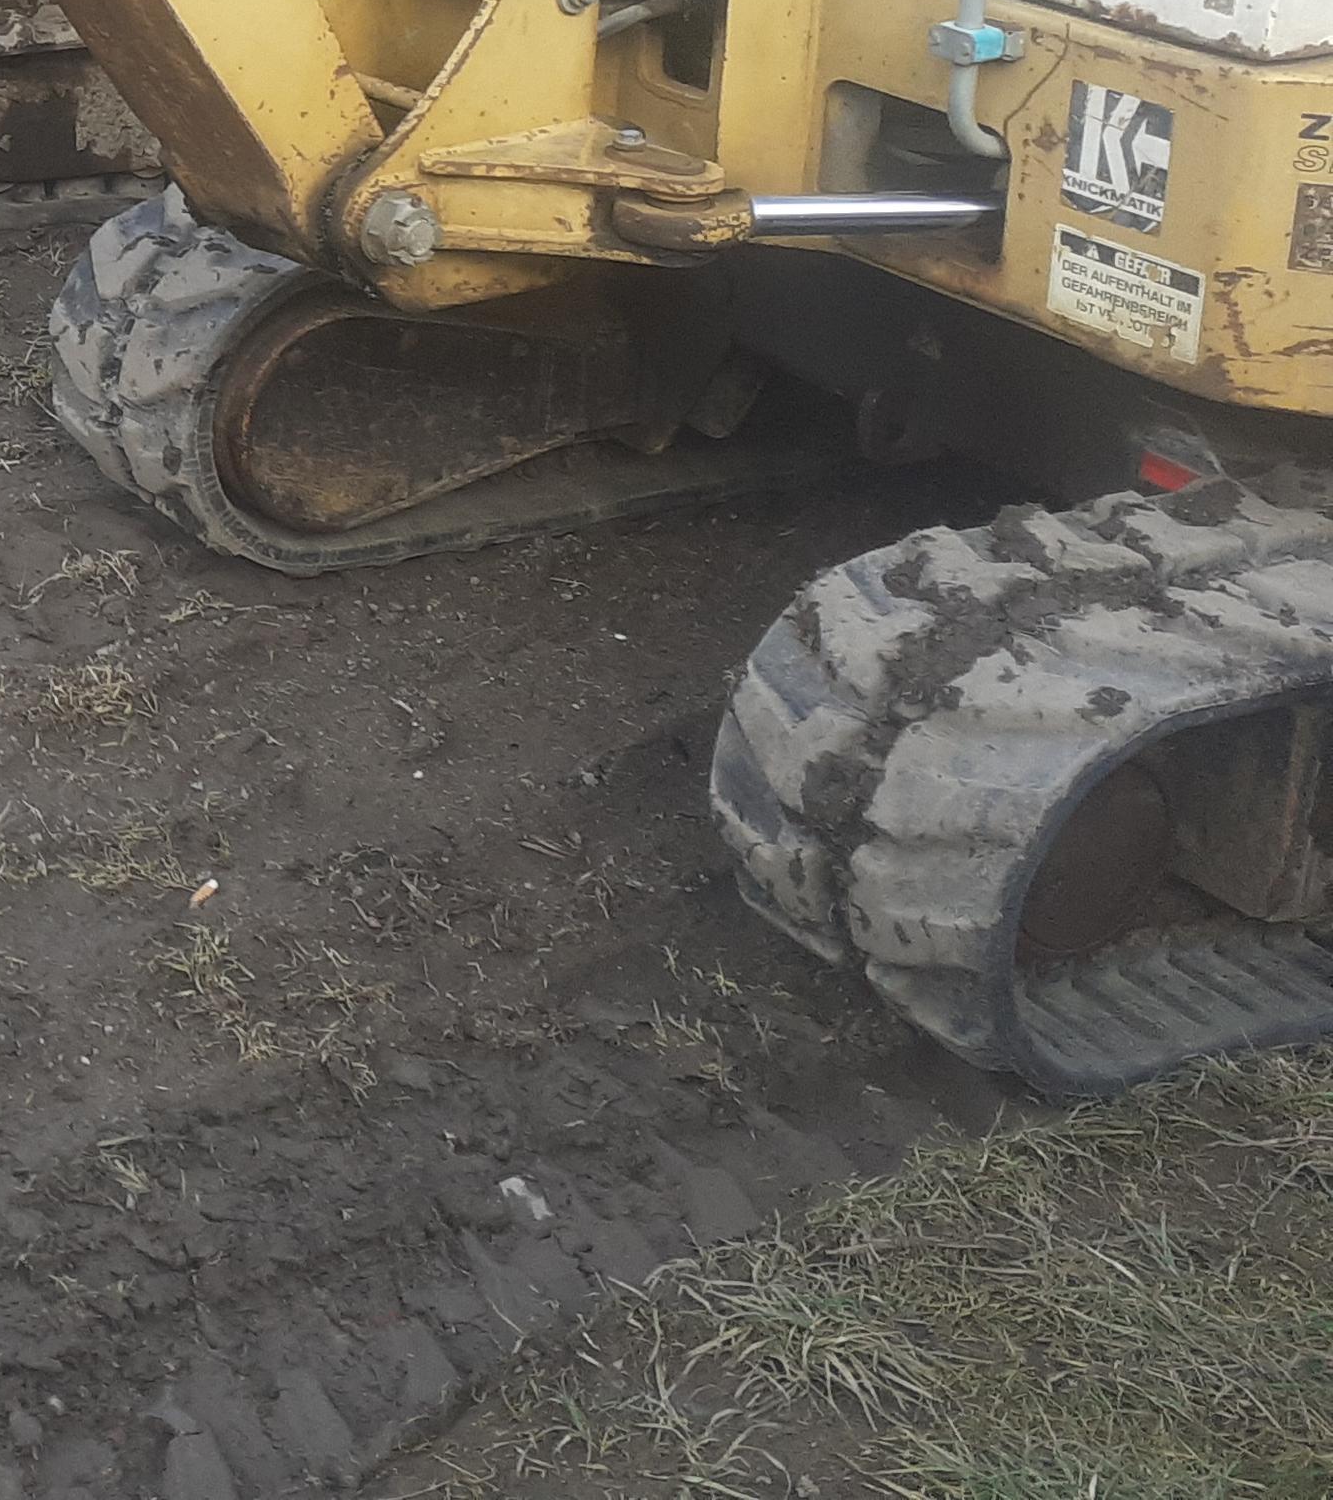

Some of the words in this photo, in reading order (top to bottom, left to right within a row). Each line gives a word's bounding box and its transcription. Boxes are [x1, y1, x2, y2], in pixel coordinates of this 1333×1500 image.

[1062, 174, 1162, 218] KNICKMATIK
[1061, 259, 1088, 277] DER
[1090, 269, 1174, 307] AUFENTHALT
[1176, 299, 1192, 315] IM
[1114, 251, 1172, 285] GEFR
[1061, 277, 1189, 332] GEFAHRENBEREICH
[1076, 298, 1098, 315] IST
[1098, 305, 1150, 336] VEOT
